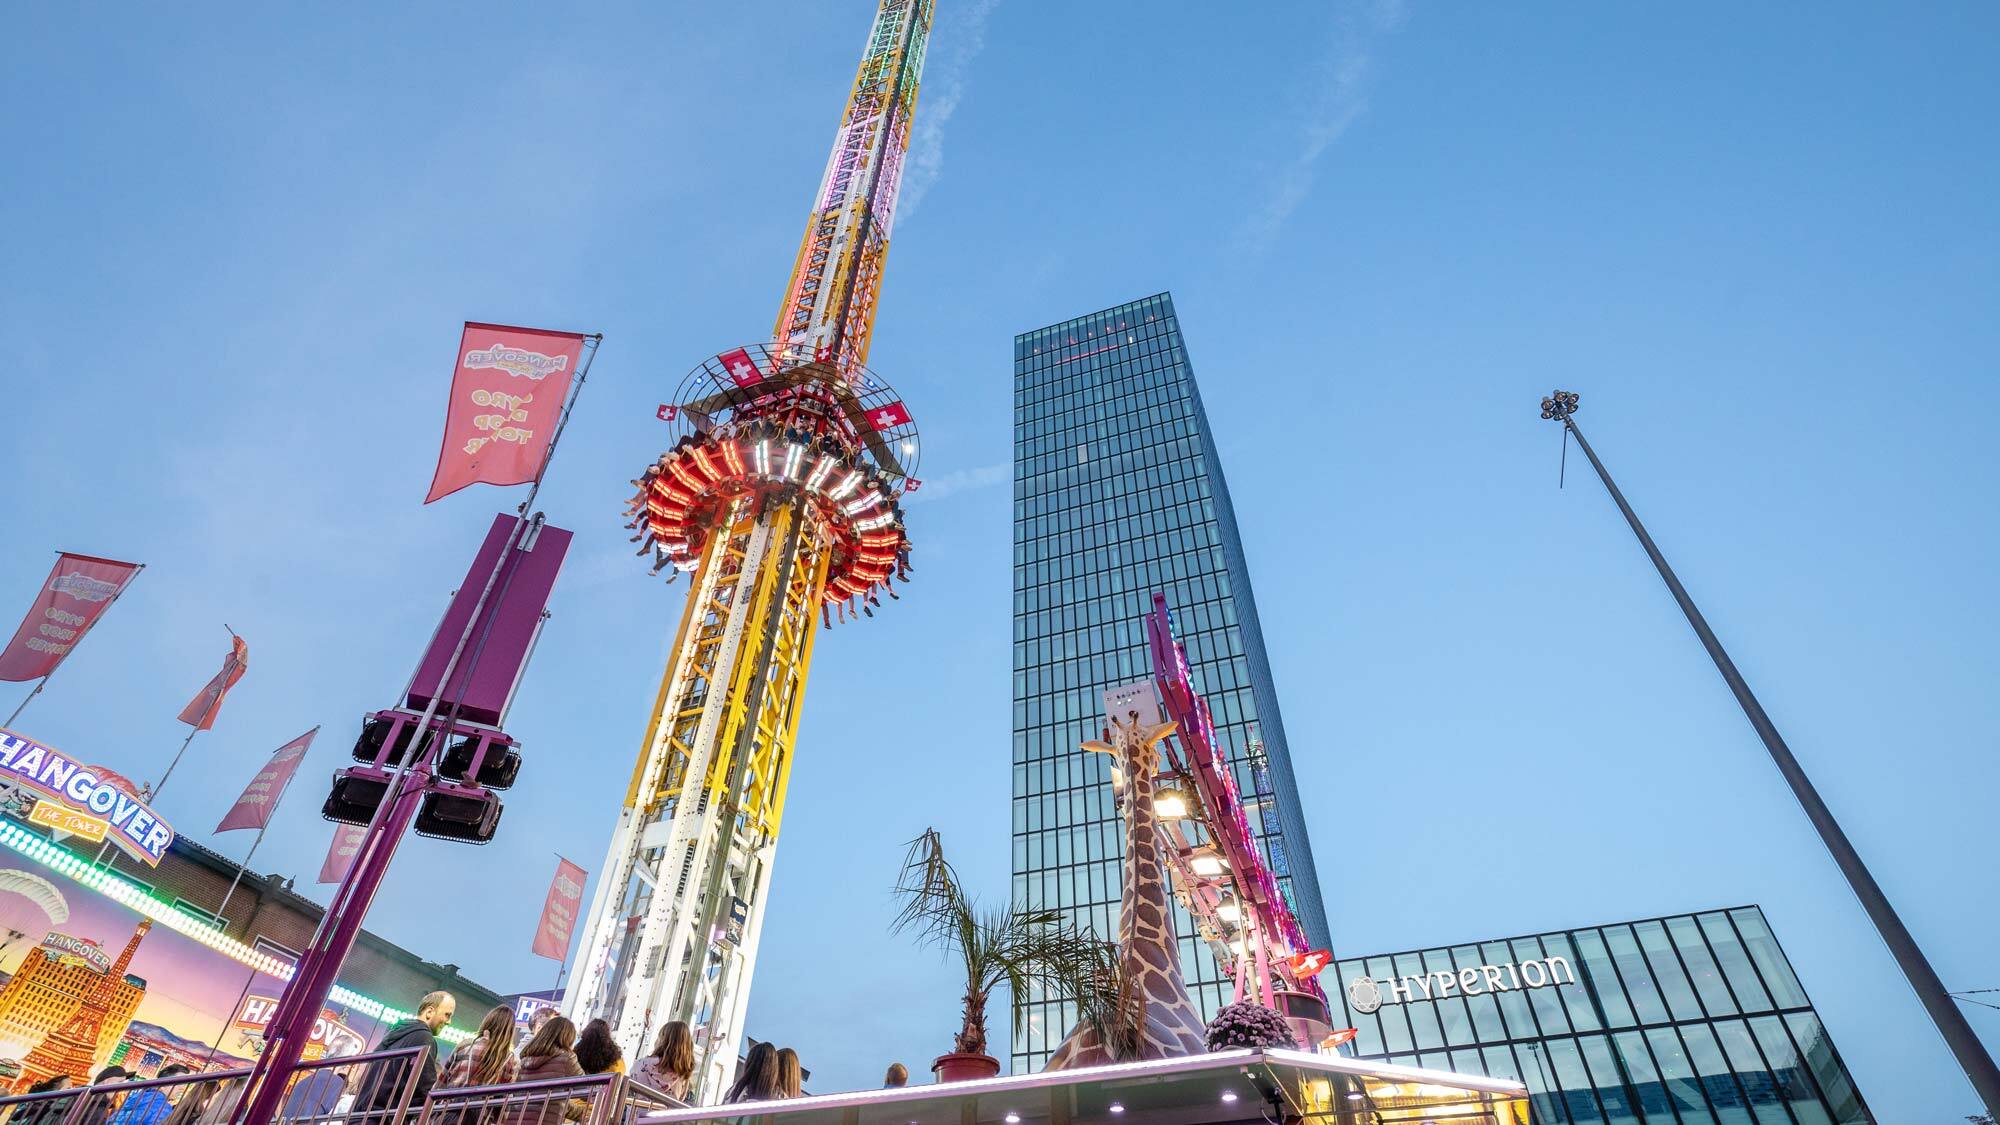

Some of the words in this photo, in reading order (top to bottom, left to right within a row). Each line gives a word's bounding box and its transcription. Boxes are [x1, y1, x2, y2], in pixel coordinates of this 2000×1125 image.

[0, 732, 170, 857] HANGOVER
[37, 807, 62, 822] THE
[63, 816, 102, 835] TOWER
[45, 933, 109, 969] HANGOVER
